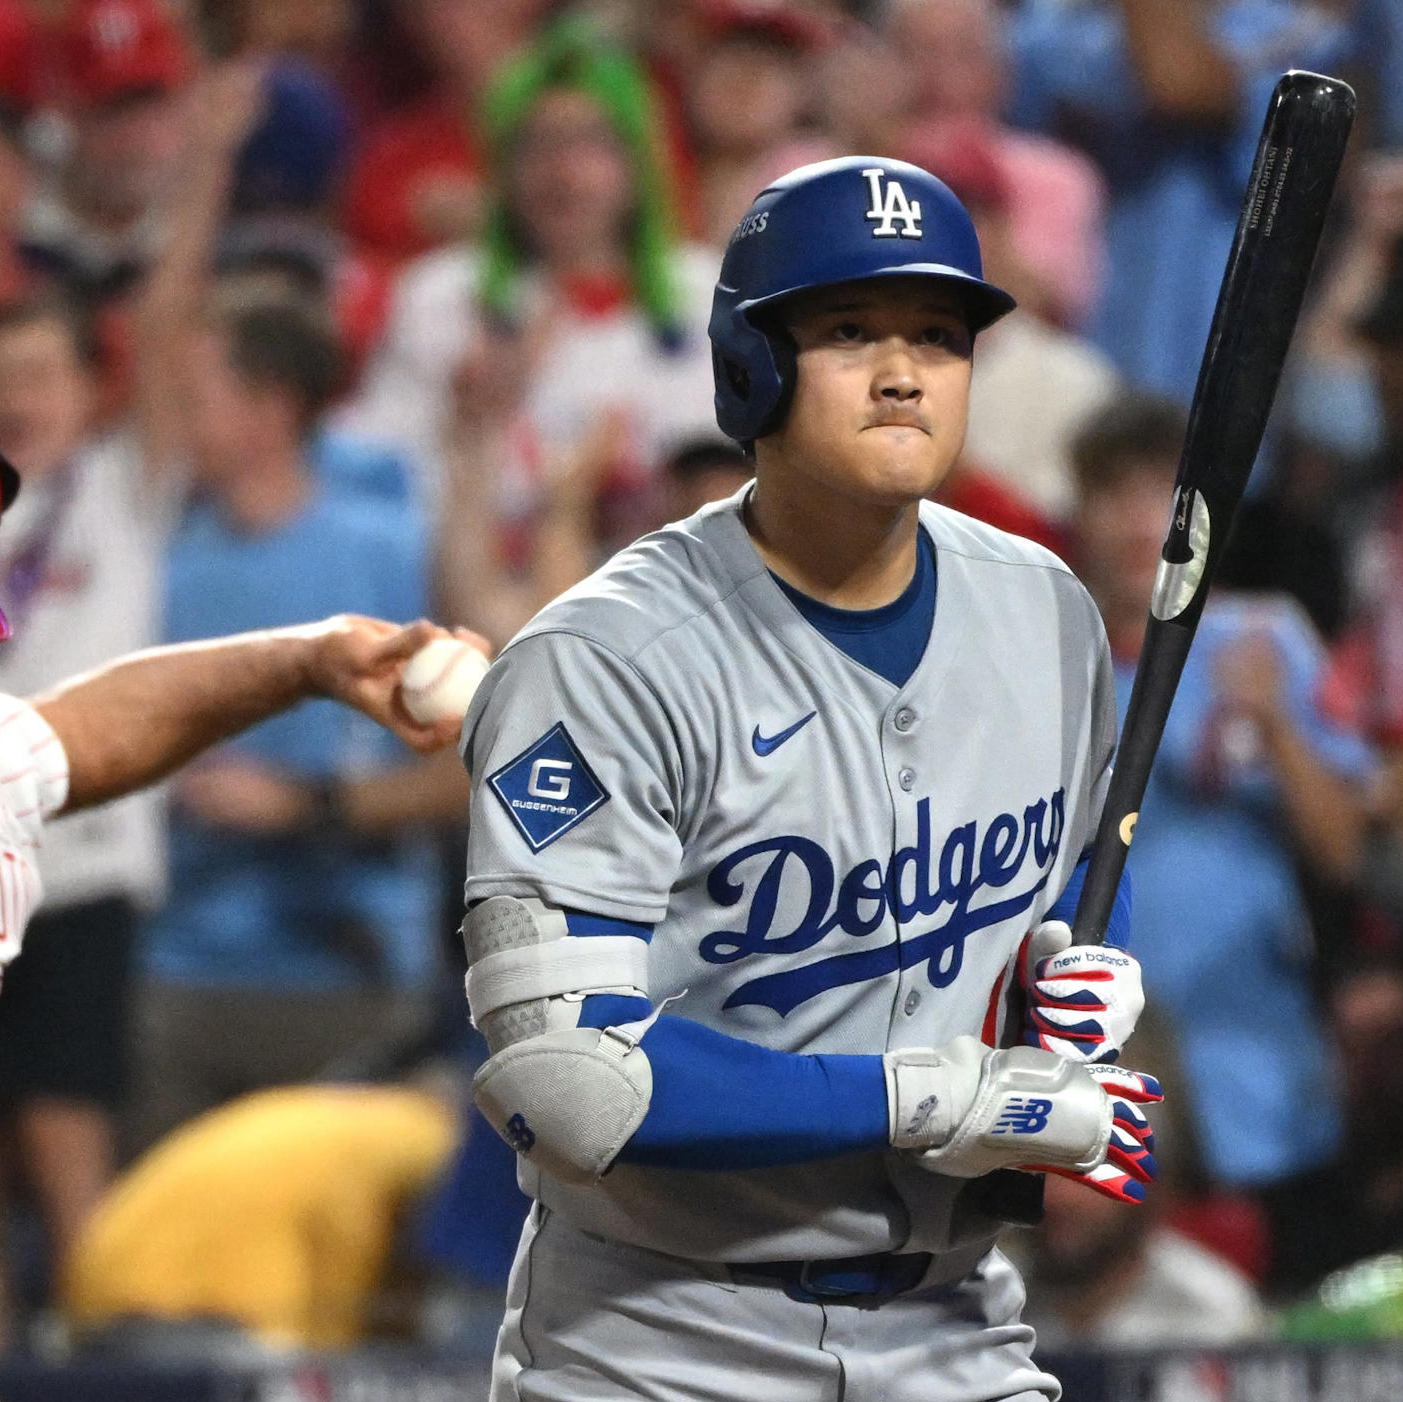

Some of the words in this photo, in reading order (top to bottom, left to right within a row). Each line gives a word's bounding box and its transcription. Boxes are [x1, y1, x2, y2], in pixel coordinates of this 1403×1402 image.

[1261, 147, 1278, 187] OHTANI
[862, 167, 923, 238] LA
[527, 758, 573, 801] G
[511, 799, 578, 816] GUGGENHEIM
[1053, 952, 1082, 970] new
[1085, 951, 1130, 968] balance
